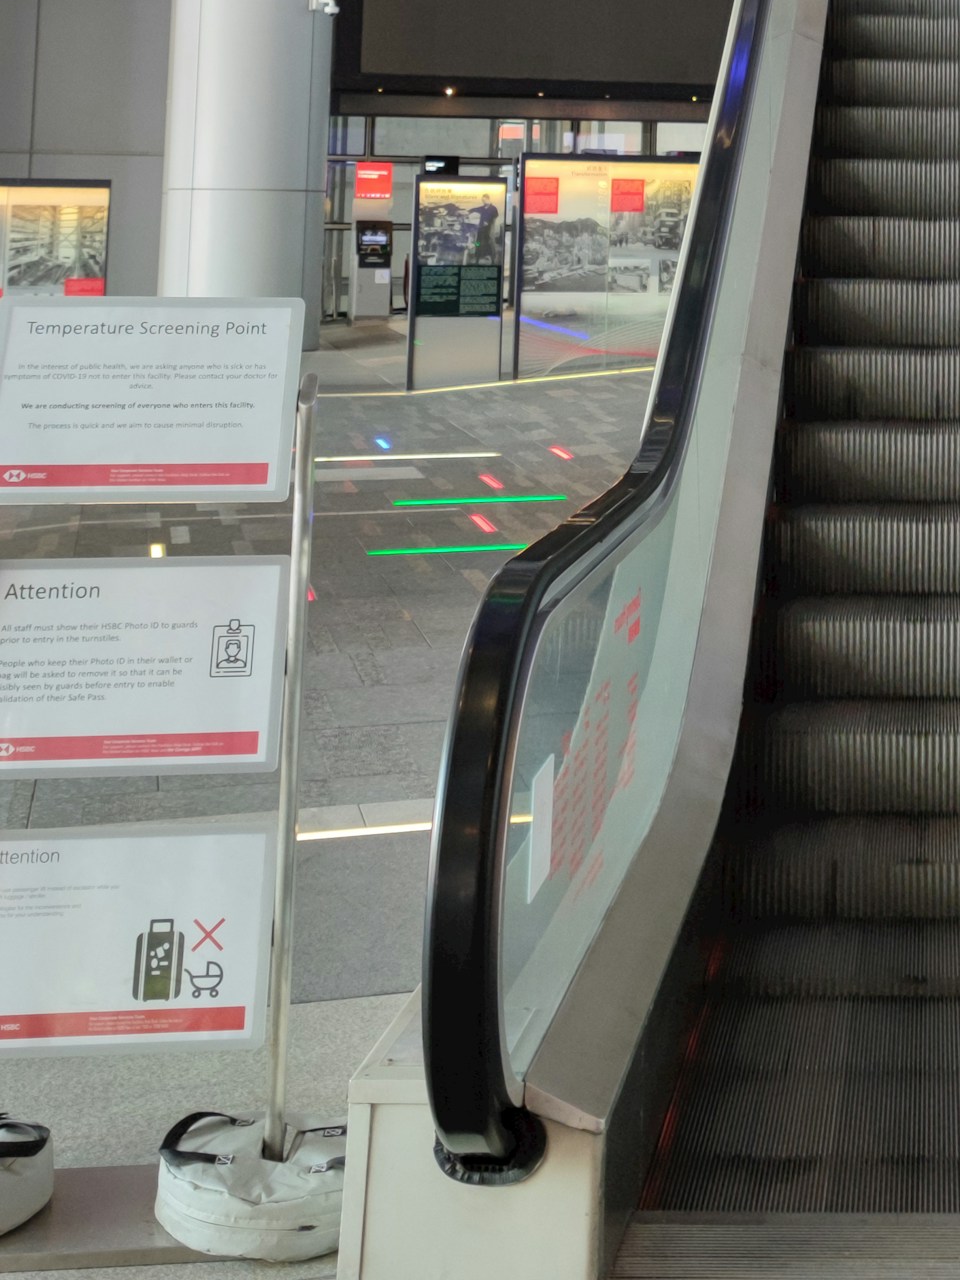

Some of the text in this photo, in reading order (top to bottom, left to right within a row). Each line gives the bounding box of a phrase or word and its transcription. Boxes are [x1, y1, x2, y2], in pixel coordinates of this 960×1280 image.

[27, 321, 267, 337] Temperature Screening Point
[4, 582, 100, 600] Attention
[1, 624, 12, 632] All
[13, 623, 32, 631] staff
[170, 621, 198, 630] guards
[0, 637, 20, 645] prior
[47, 659, 67, 667] keep
[90, 657, 114, 665] Photo
